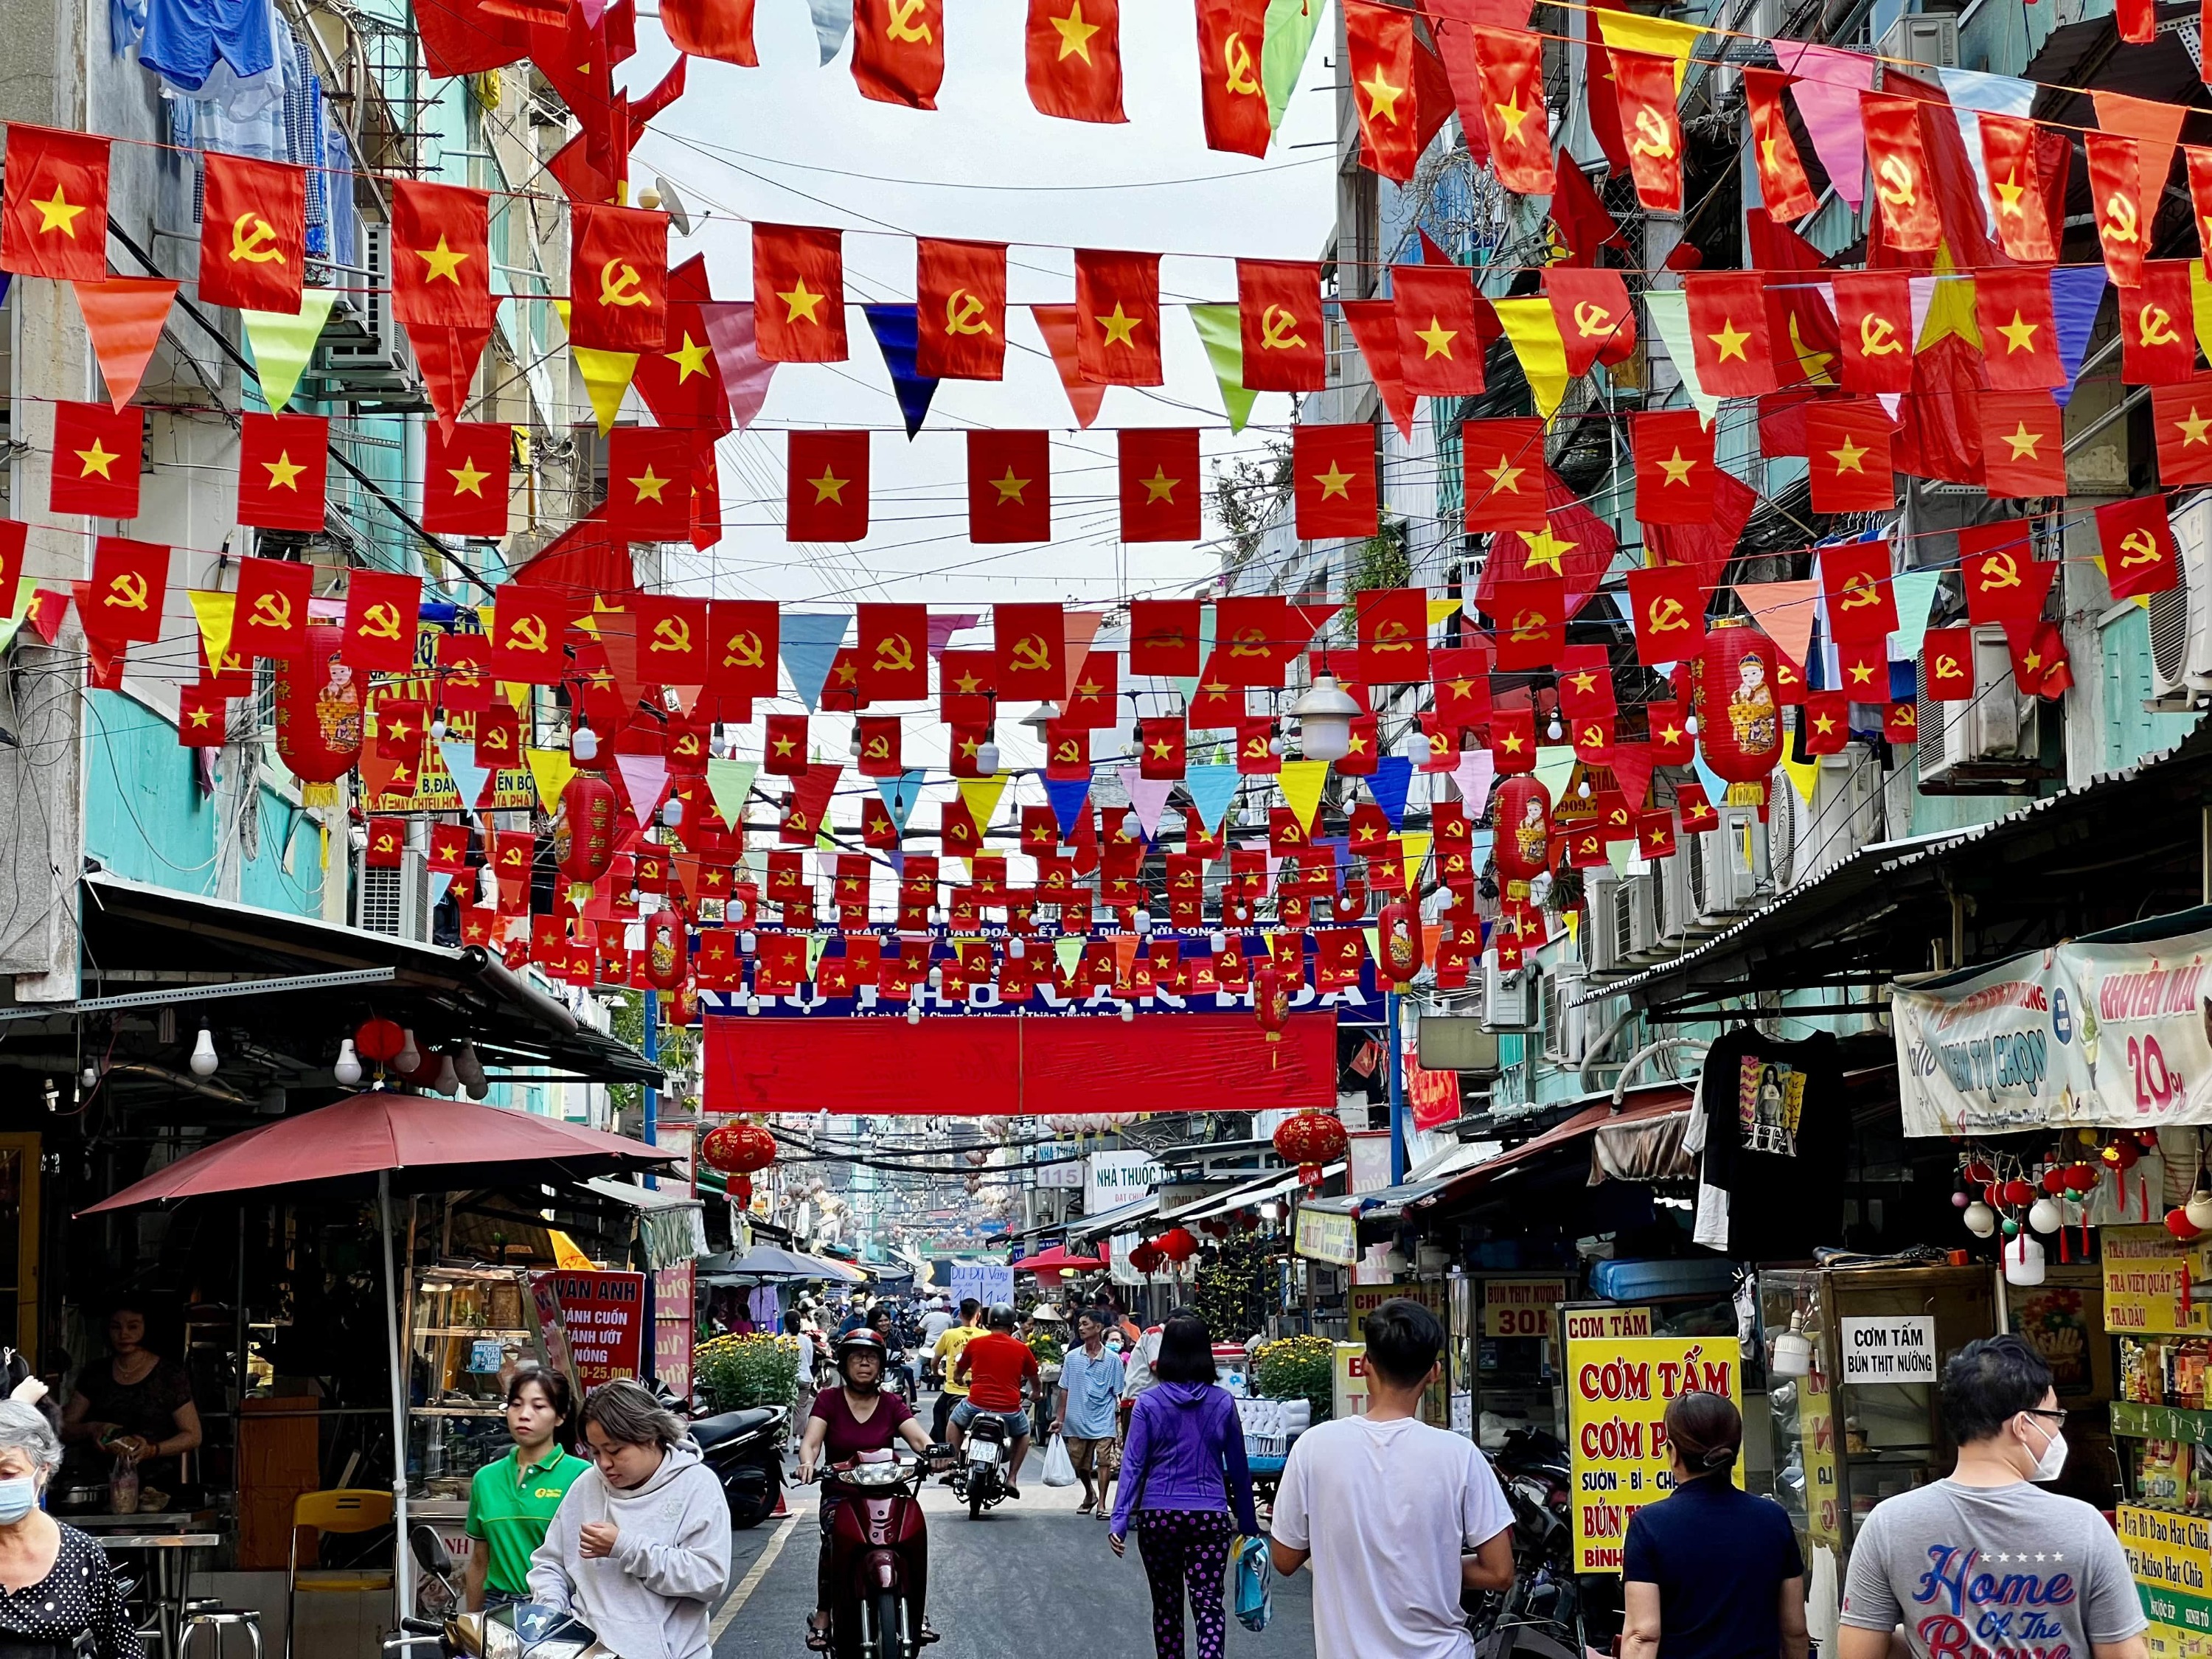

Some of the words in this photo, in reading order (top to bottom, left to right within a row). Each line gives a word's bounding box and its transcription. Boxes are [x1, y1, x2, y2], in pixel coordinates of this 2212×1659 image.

[594, 1307, 627, 1326] CUỐN
[1568, 1317, 1605, 1339] CƠM
[1610, 1308, 1648, 1337] TẤM
[1854, 1326, 1887, 1348] CƠM
[1891, 1321, 1924, 1346] TẤM
[1579, 1355, 1651, 1402] CƠM
[1657, 1343, 1732, 1401] TẤM
[1847, 1350, 1869, 1373] BÚN
[1871, 1354, 1893, 1377] THỊT
[1897, 1349, 1933, 1372] NƯỚNG
[1581, 1414, 1644, 1460] CƠM
[1582, 1496, 1621, 1538] BÚN
[2188, 1522, 2209, 1551] Chia
[1911, 1543, 2077, 1619] Home
[2141, 1551, 2163, 1579] Atiso
[2183, 1559, 2204, 1589] Chia
[1976, 1610, 2014, 1645] Of
[2017, 1611, 2063, 1640] The
